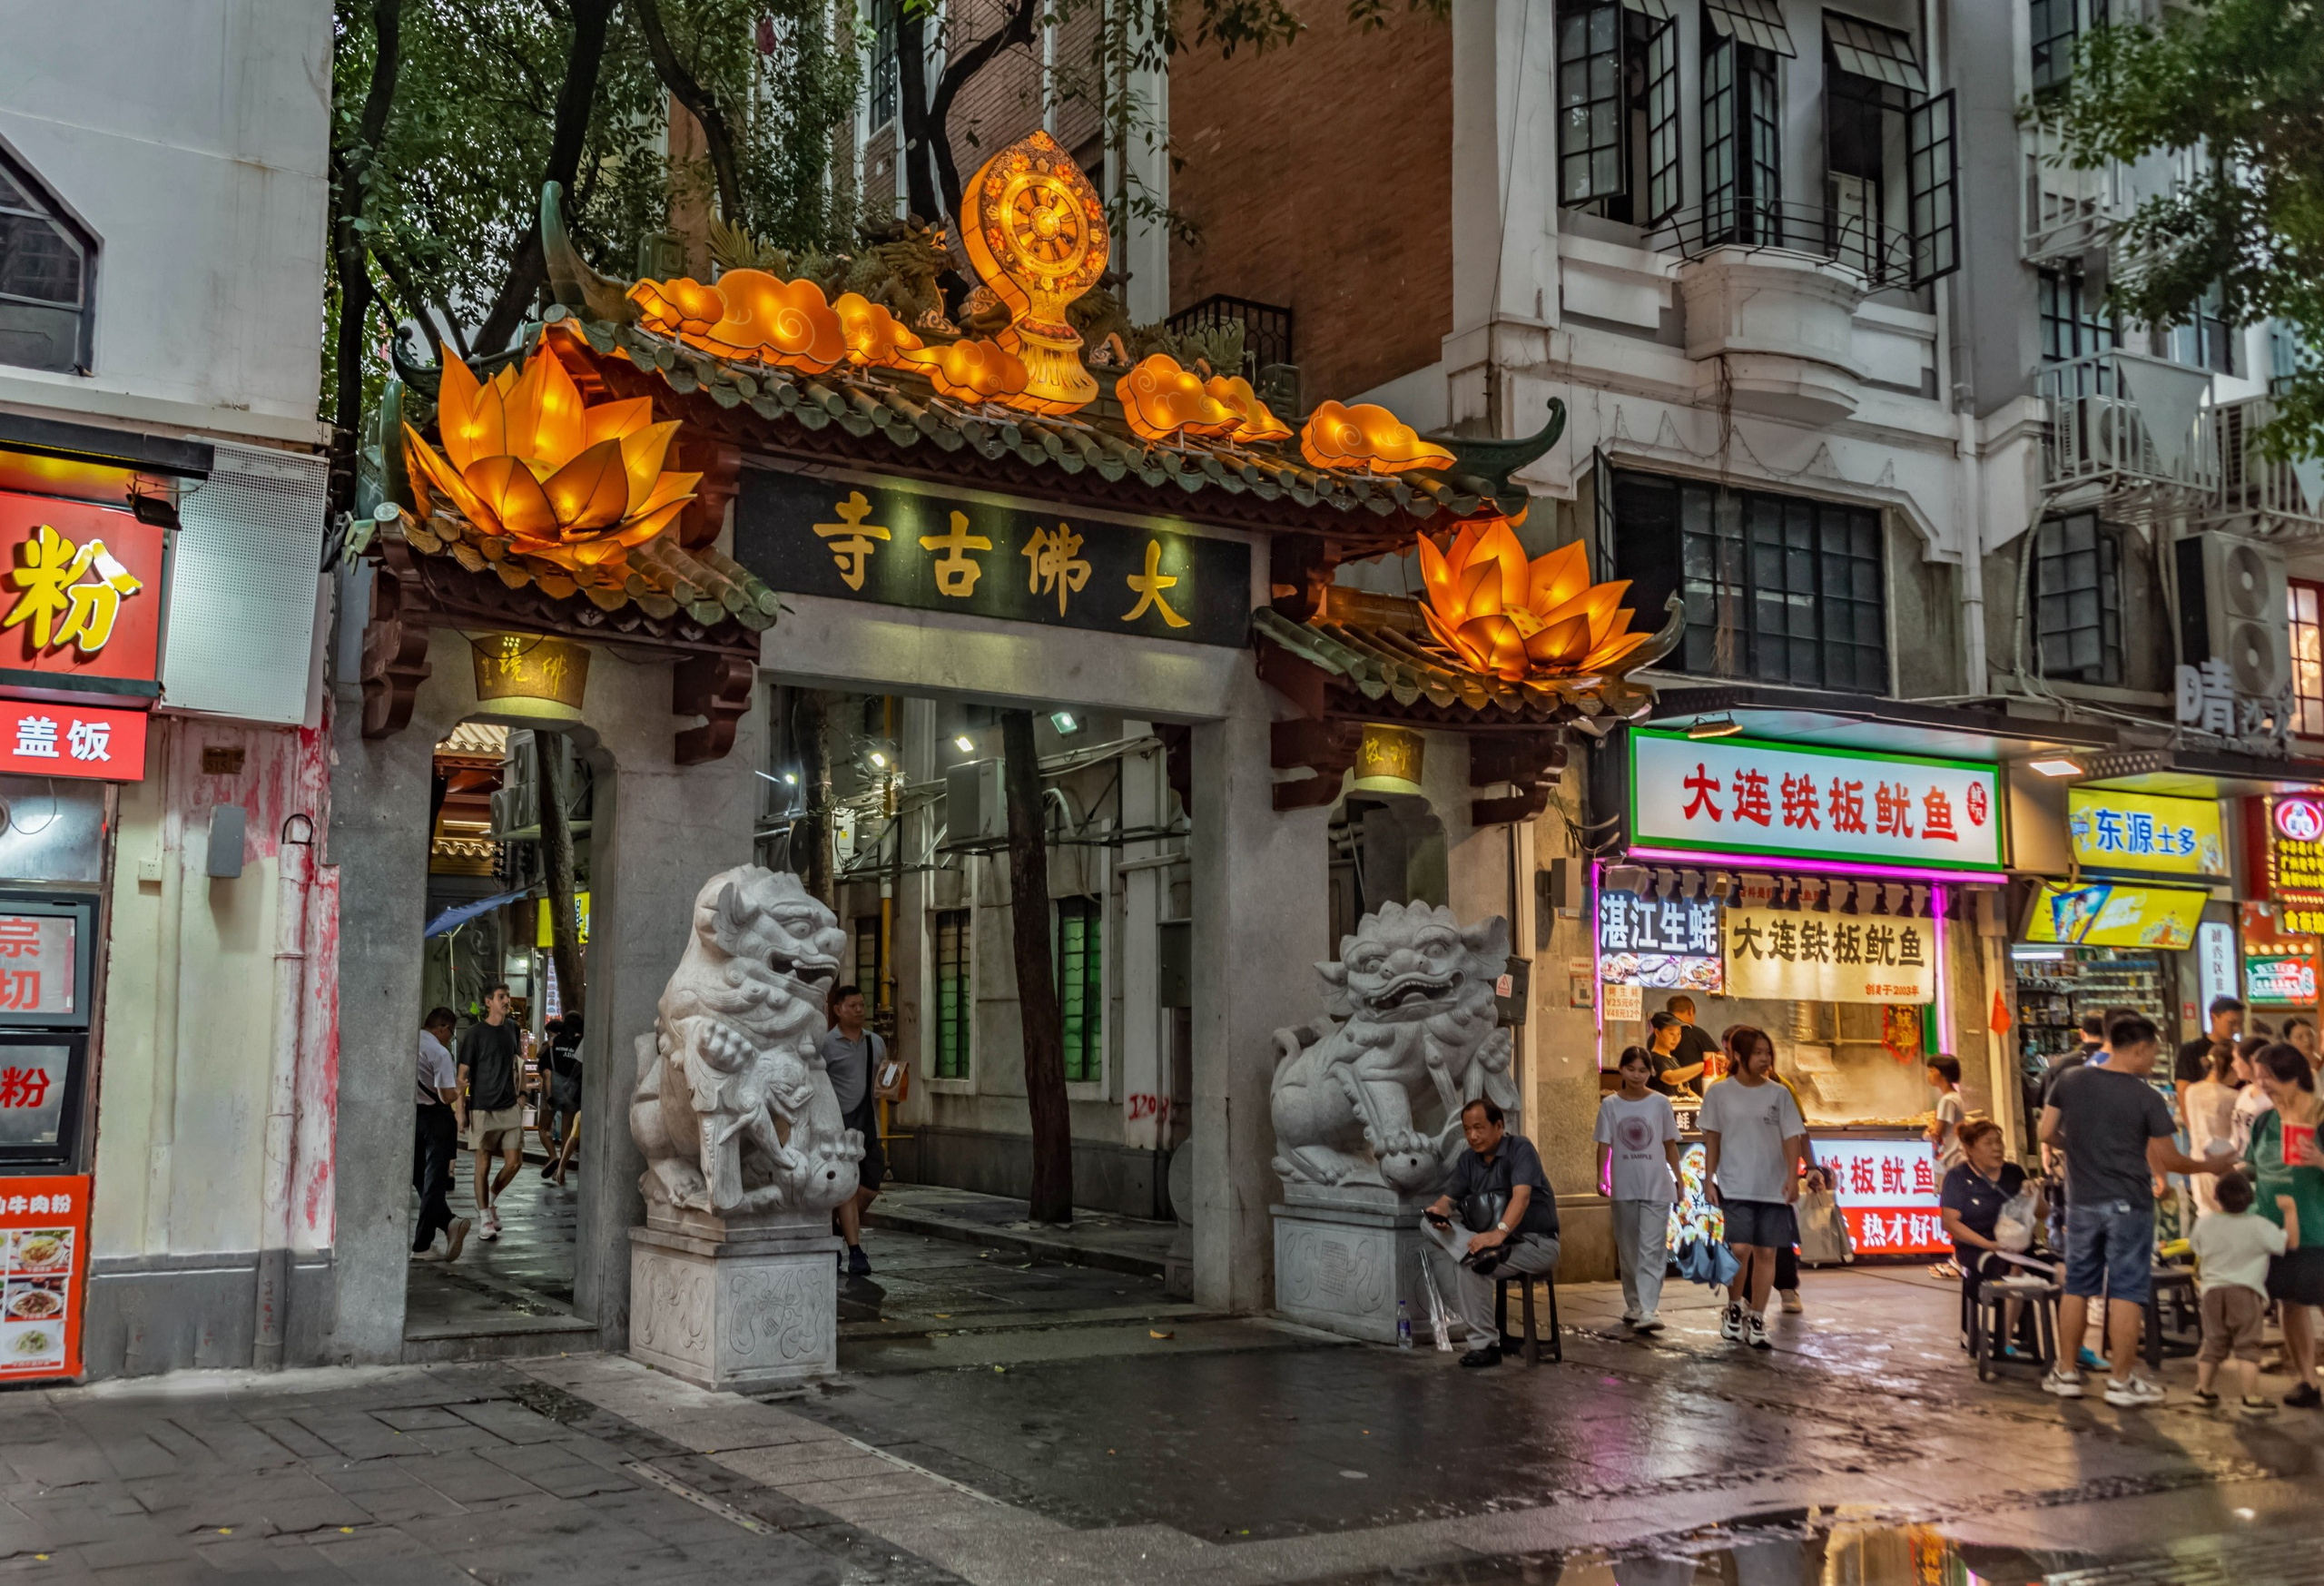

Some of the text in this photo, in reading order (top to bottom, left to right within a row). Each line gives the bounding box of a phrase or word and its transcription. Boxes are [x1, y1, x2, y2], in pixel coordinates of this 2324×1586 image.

[4, 524, 143, 653] 粉
[13, 715, 112, 762] 盖饭
[1682, 763, 1958, 842] 大连铁板鱿鱼
[2095, 809, 2196, 855] 东源士多
[1600, 894, 1718, 954] 湛江生蚝
[1732, 917, 1925, 967] 大连铁板鱿鱼
[1, 1066, 50, 1108] 粉
